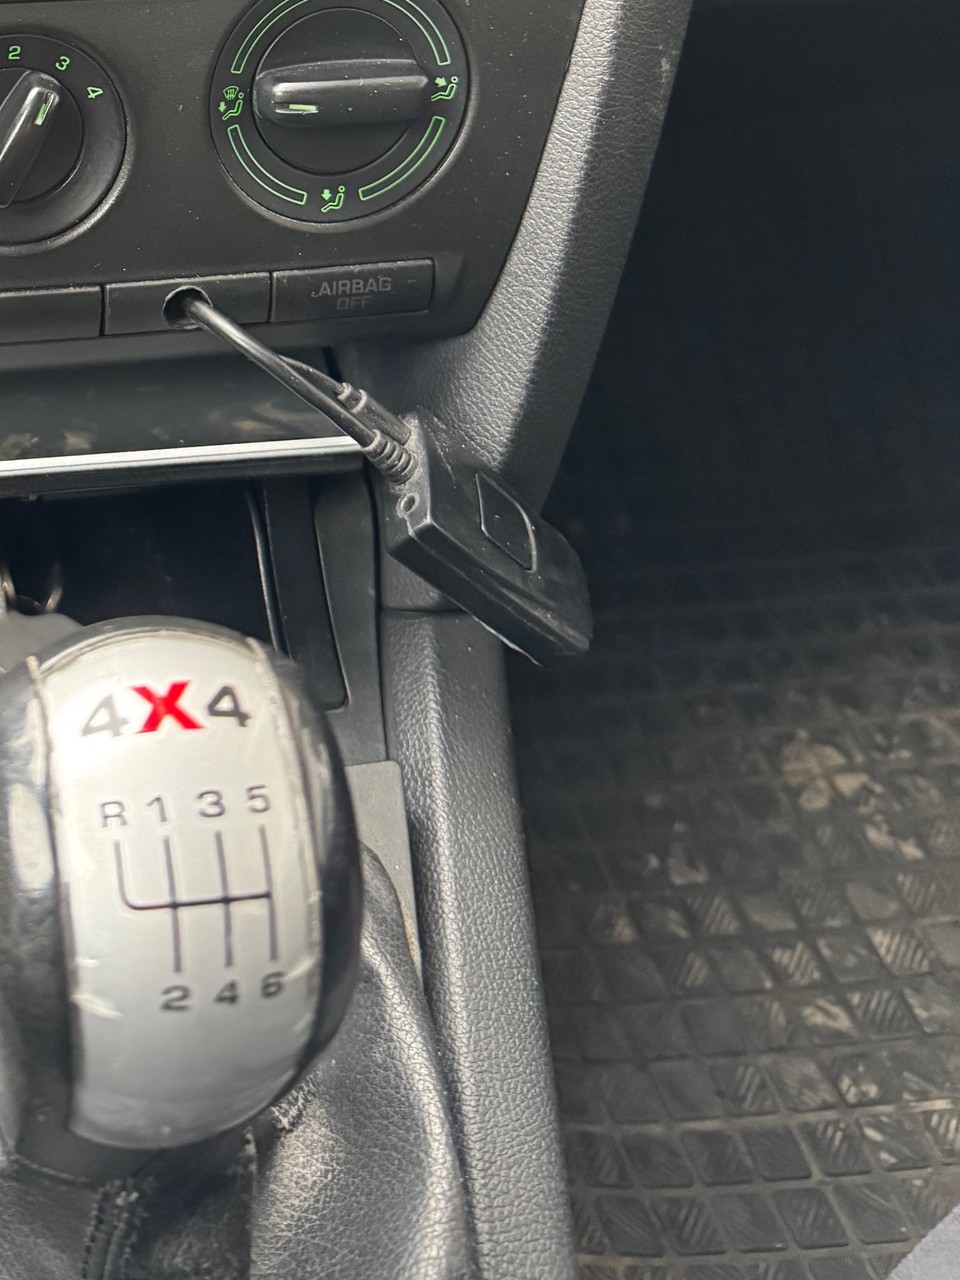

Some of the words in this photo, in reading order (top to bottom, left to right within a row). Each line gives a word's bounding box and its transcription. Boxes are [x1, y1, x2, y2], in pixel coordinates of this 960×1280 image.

[7, 45, 21, 60] 2
[55, 55, 71, 71] 3
[86, 86, 103, 99] 4
[318, 277, 392, 296] AIRBAG
[335, 296, 372, 310] OFF
[99, 801, 127, 828] R
[145, 796, 168, 823] 1
[196, 790, 226, 818] 3
[245, 785, 272, 813] 5
[160, 984, 192, 1012] 2
[213, 979, 240, 1005] 4
[260, 972, 286, 999] 6
